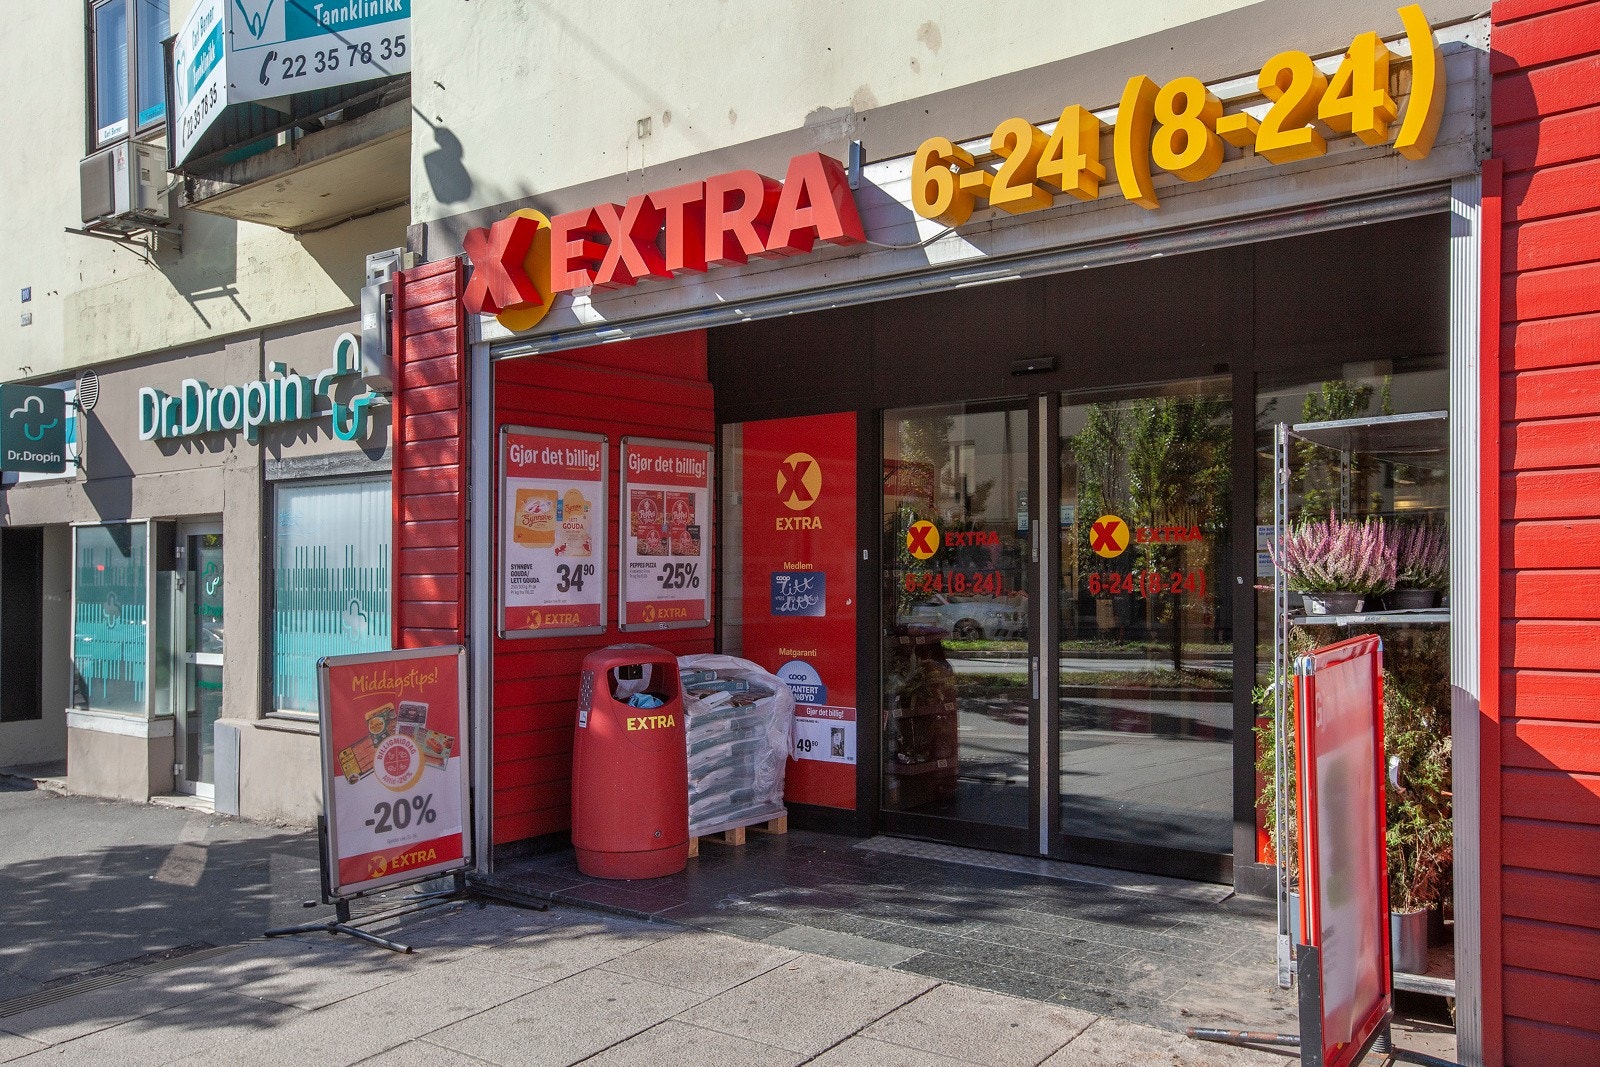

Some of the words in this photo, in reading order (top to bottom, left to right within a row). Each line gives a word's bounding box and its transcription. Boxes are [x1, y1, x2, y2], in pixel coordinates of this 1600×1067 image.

[313, 0, 403, 27] Tannklinikk
[281, 54, 307, 80] 22
[314, 48, 340, 73] 35
[347, 41, 372, 67] 78
[380, 34, 406, 61] 35
[187, 115, 194, 140] 22
[193, 104, 201, 130] 35
[201, 94, 209, 119] 78
[209, 82, 218, 108] 35
[550, 151, 867, 293] EXTRA
[139, 361, 308, 441] Dr.Dropin
[8, 449, 61, 463] Dr.Dropin
[509, 444, 539, 467] Gjør
[541, 447, 564, 466] det
[565, 448, 600, 472] billig!
[628, 452, 653, 474] Gjør
[654, 456, 674, 473] det
[675, 457, 706, 479] billig!
[562, 522, 585, 530] GOUDA
[775, 516, 823, 530] EXTRA
[945, 531, 1000, 547] EXTRA
[1136, 525, 1204, 543] EXTRA
[657, 562, 700, 589] -25%
[783, 561, 813, 570] Medlem
[545, 612, 581, 625] EXTRA
[657, 607, 688, 619] EXTRA
[778, 647, 817, 658] Matgaranti
[352, 666, 438, 698] Middagstips!
[788, 673, 807, 682] coop
[627, 714, 675, 731] EXTRA
[377, 737, 417, 760] BILLIGMIDDAG
[365, 793, 437, 834] -20%
[391, 848, 437, 869] EXTRA
